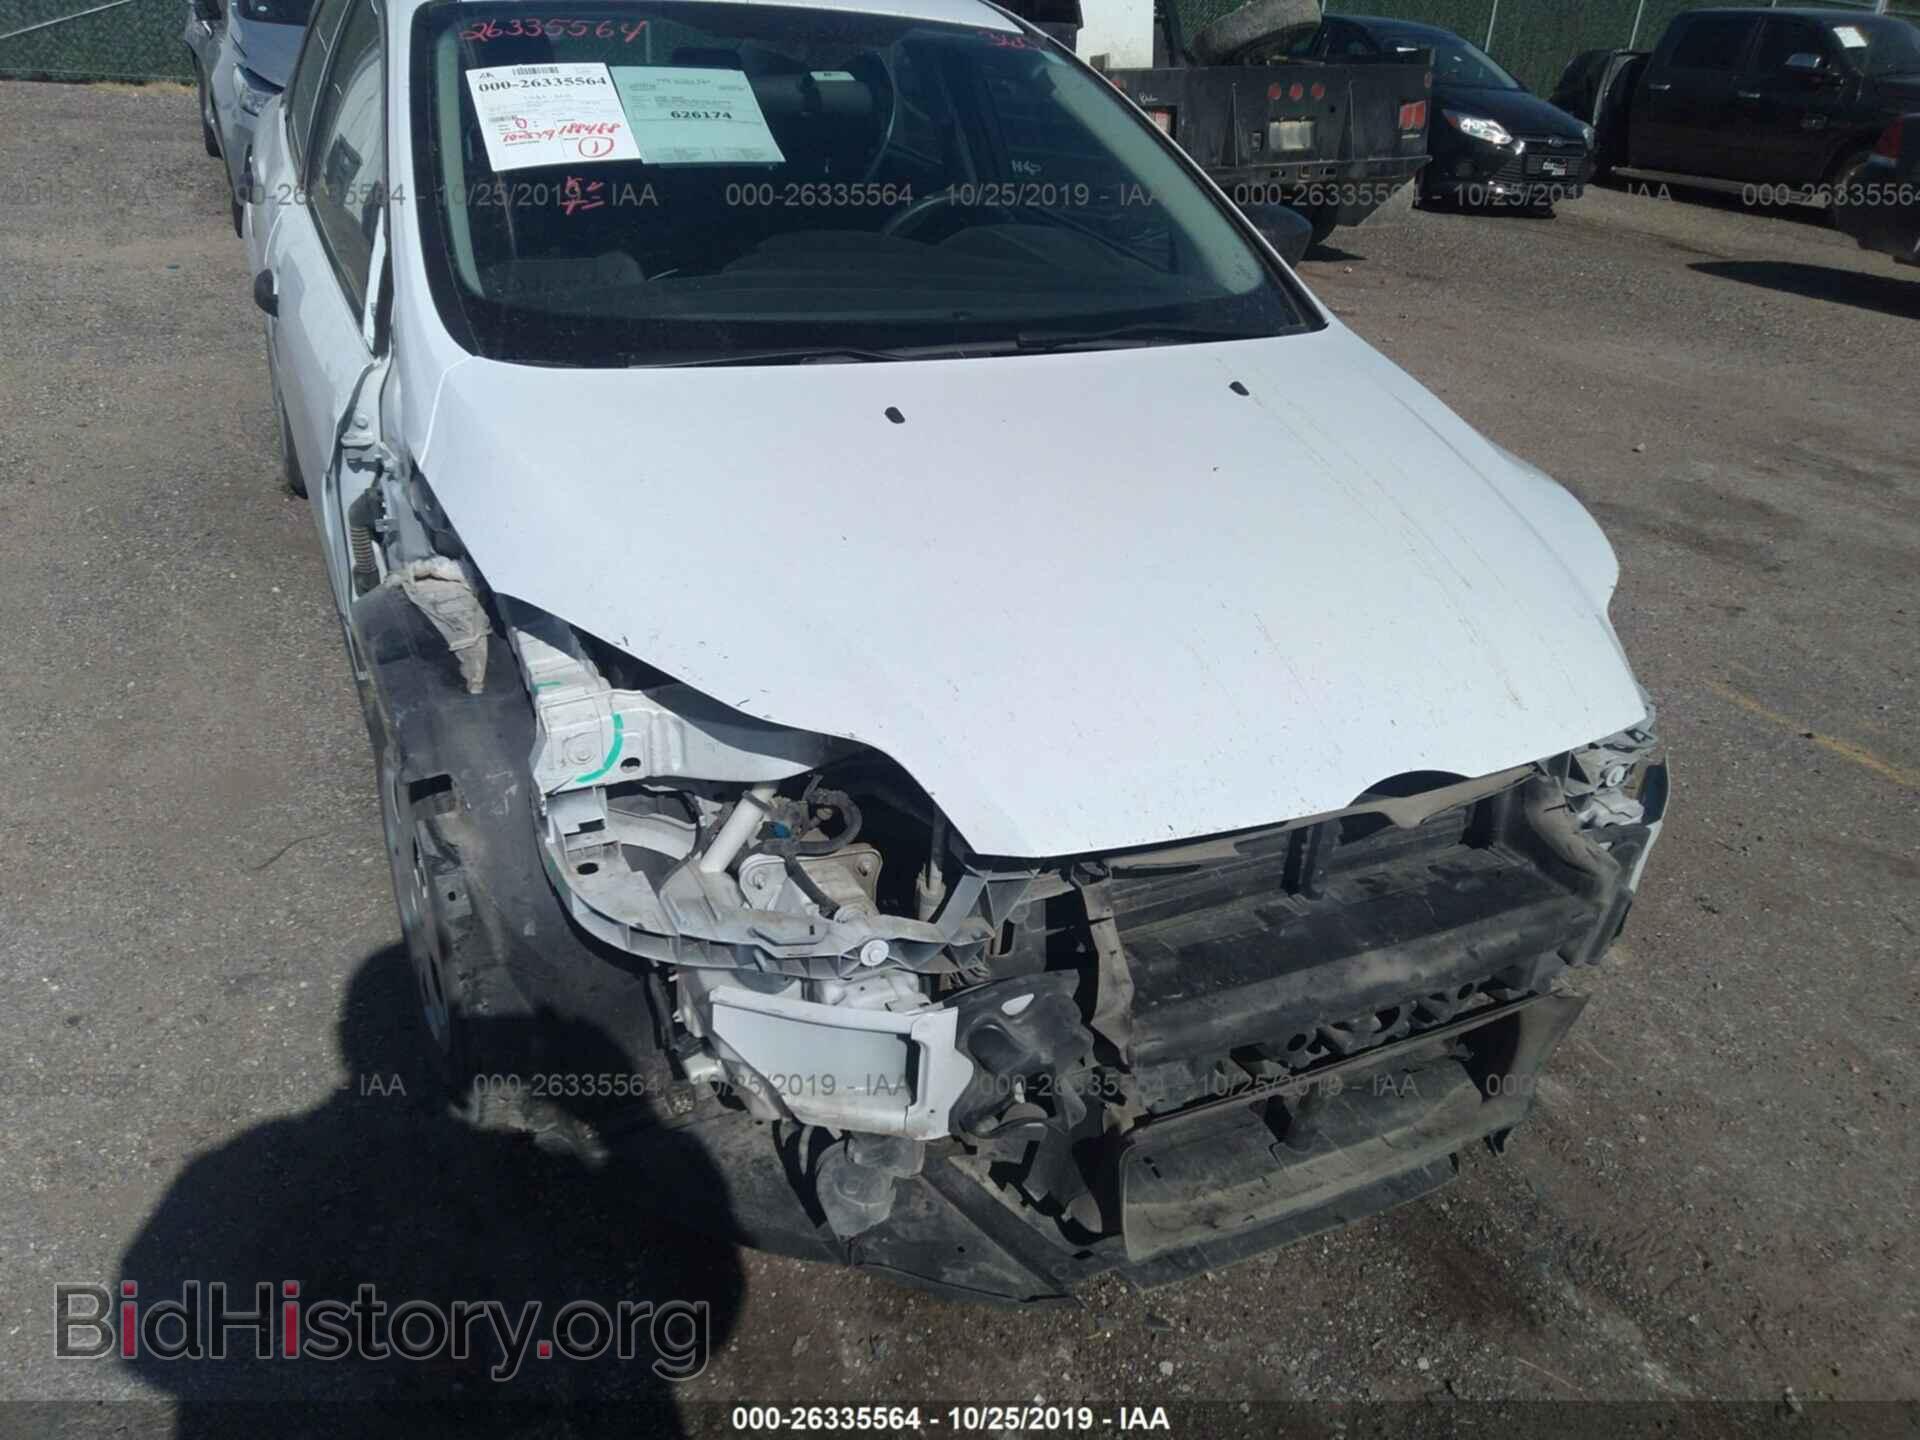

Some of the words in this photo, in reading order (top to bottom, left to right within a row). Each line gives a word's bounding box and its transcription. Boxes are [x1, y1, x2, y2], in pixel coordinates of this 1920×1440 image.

[459, 17, 650, 43] 26335564
[478, 76, 608, 93] 000-26335564
[670, 110, 733, 120] 626174
